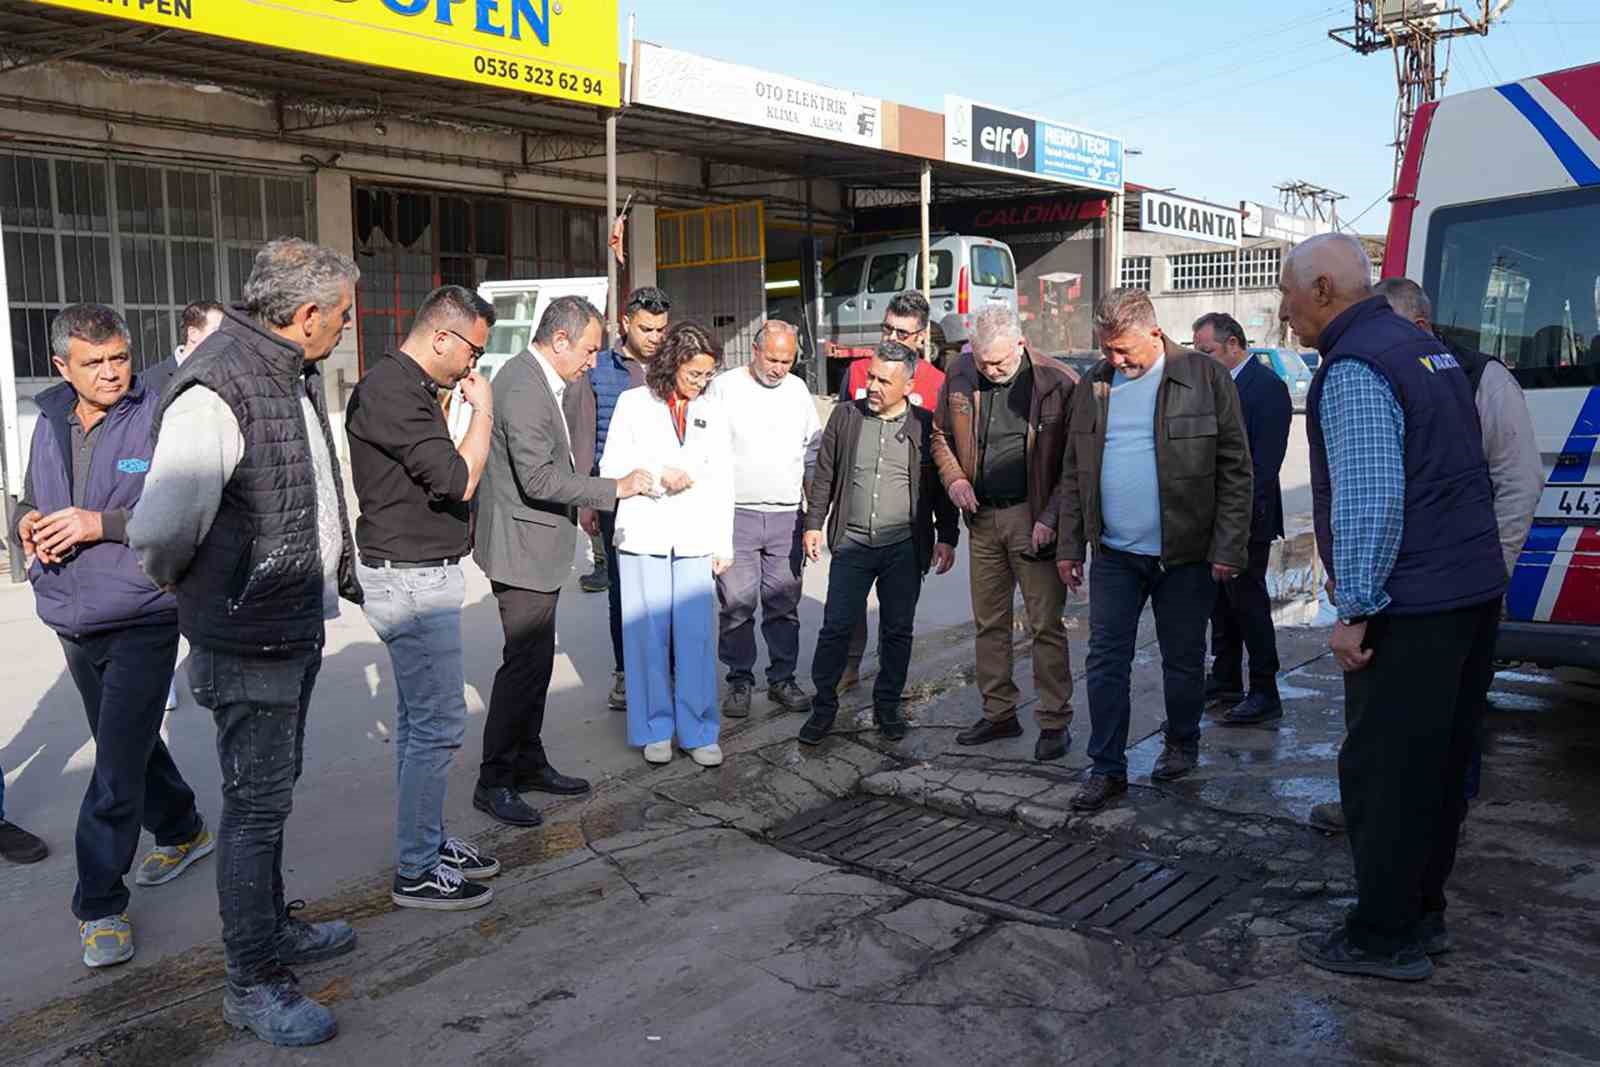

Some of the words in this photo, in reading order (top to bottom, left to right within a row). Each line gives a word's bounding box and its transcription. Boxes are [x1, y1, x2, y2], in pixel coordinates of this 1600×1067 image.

[474, 55, 519, 80] 0536
[524, 65, 554, 87] 323
[559, 72, 578, 92] 62
[583, 77, 603, 96] 94
[755, 81, 783, 101] OTO
[766, 105, 800, 124] KLIMA
[980, 126, 1012, 154] elf
[1080, 135, 1110, 157] TECH
[1147, 198, 1237, 241] LOKANTA
